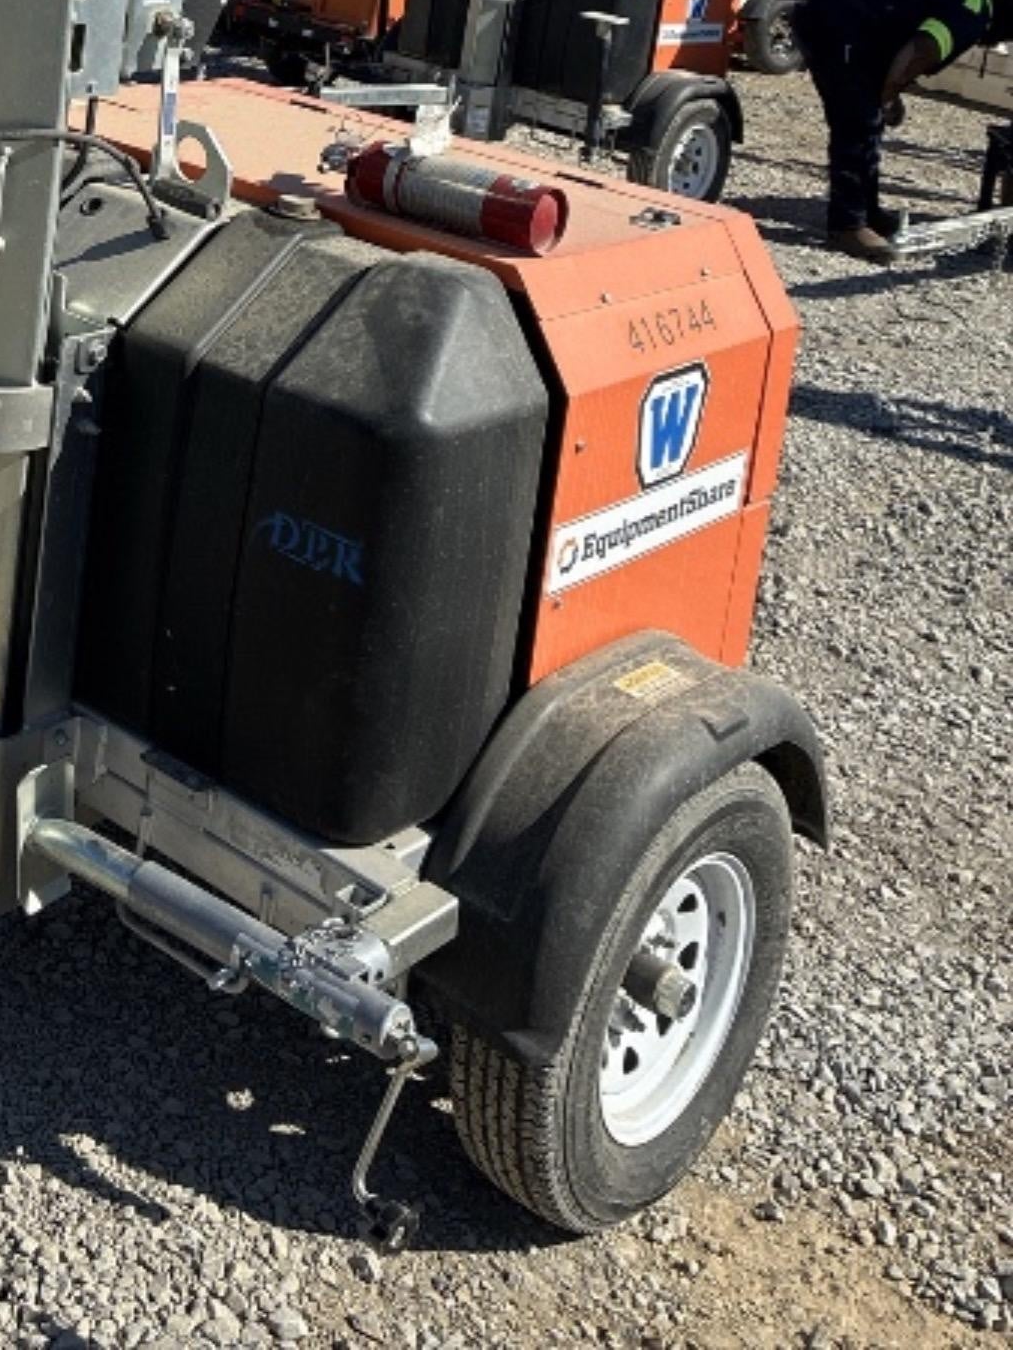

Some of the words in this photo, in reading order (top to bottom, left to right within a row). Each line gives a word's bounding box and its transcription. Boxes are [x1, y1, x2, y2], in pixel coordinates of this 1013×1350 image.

[628, 299, 717, 353] 416744
[649, 383, 700, 470] W
[581, 479, 736, 561] EquipmentShare
